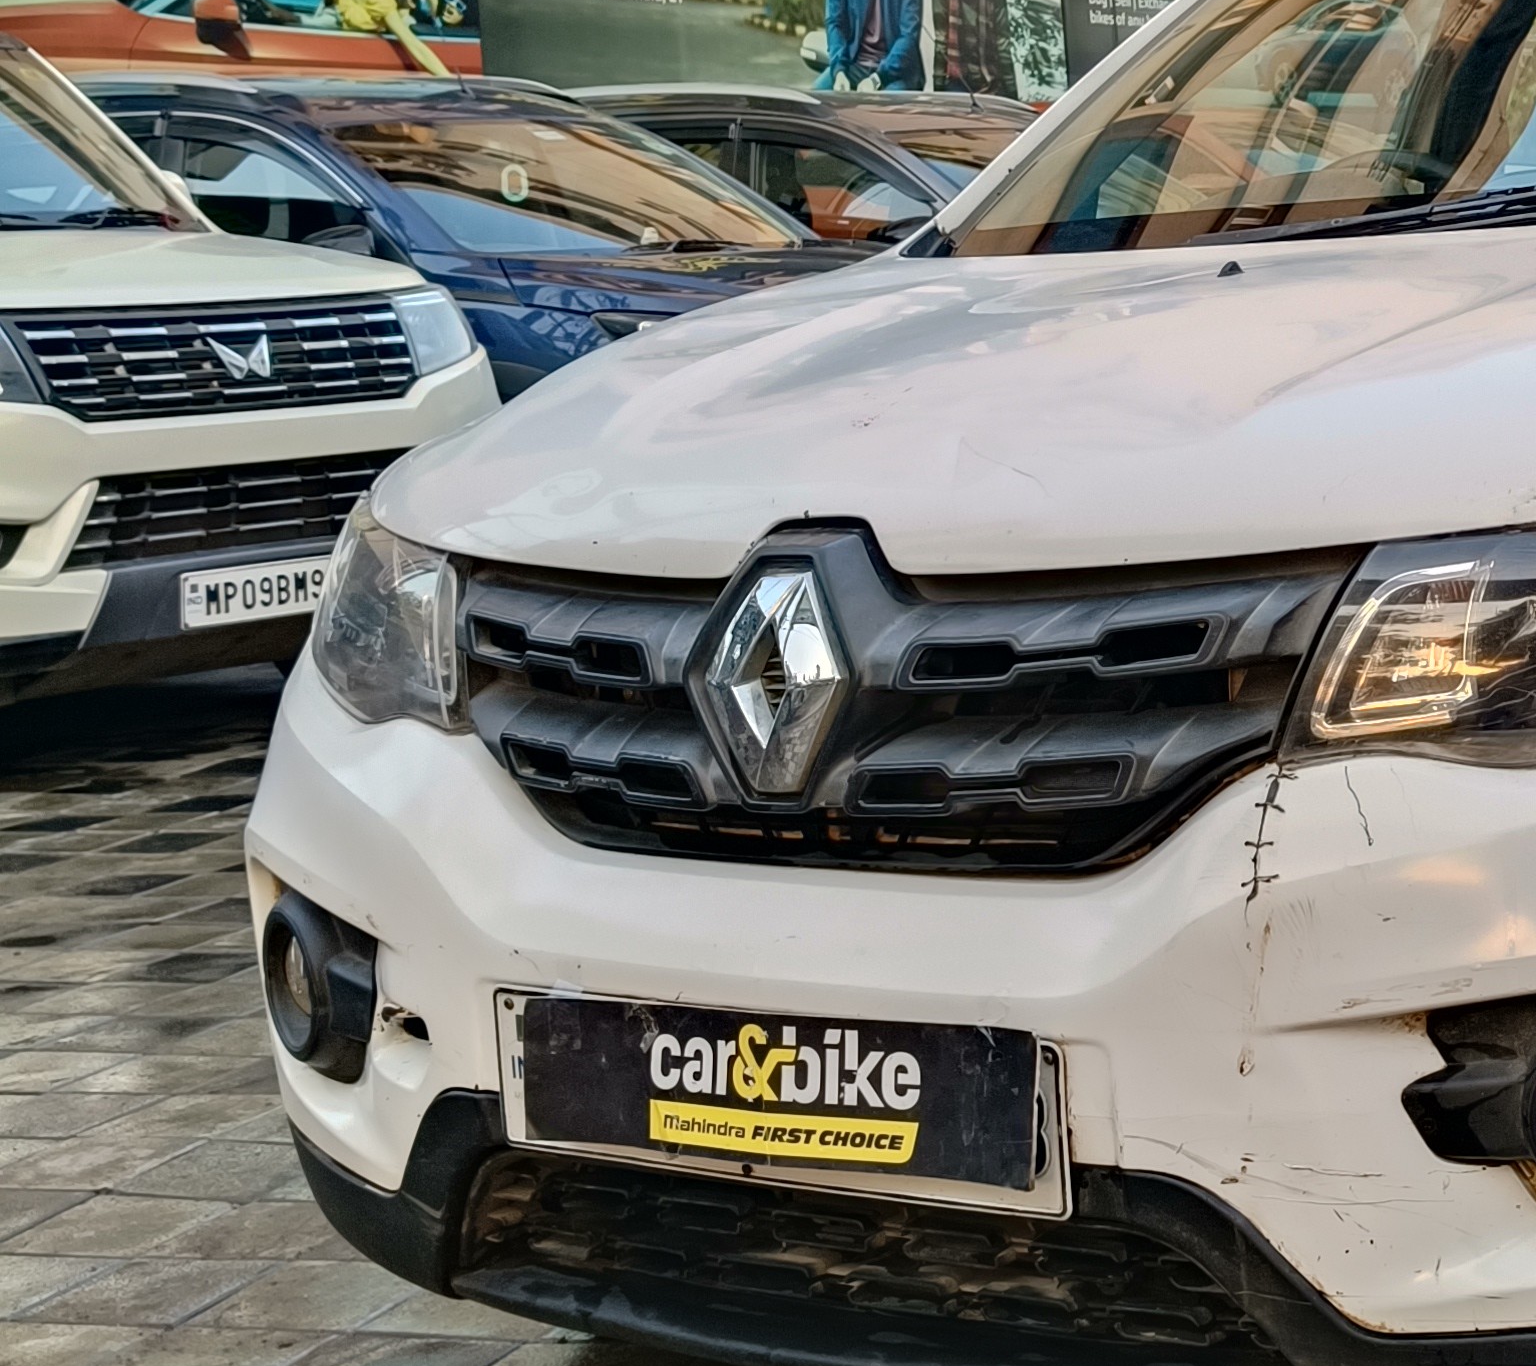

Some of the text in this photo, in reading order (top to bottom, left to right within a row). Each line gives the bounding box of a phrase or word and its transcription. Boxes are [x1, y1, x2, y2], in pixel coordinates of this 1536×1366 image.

[1089, 9, 1115, 25] bikes
[1116, 12, 1126, 26] of
[650, 1023, 922, 1110] car&bike
[663, 1113, 905, 1151] Mahindra FIRST CHOICE
